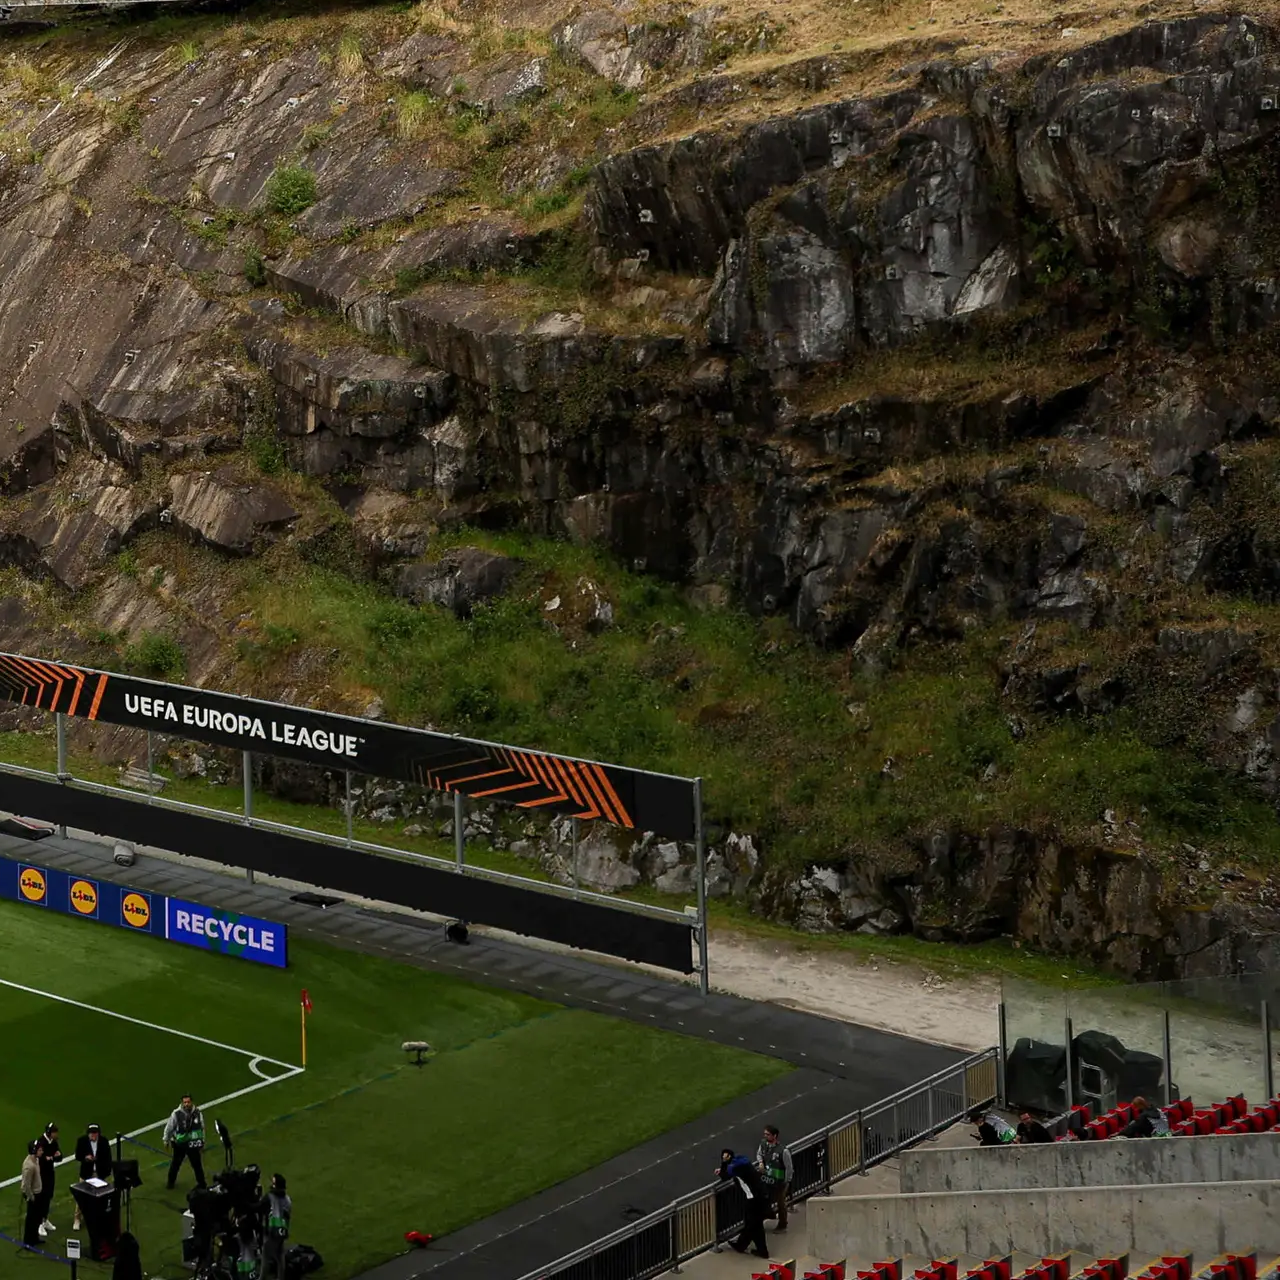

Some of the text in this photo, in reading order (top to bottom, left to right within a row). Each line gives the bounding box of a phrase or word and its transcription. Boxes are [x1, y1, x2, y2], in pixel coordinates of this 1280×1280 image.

[125, 693, 358, 757] UEFA EUROPA LEAGUE
[176, 910, 275, 952] RECYCLE
